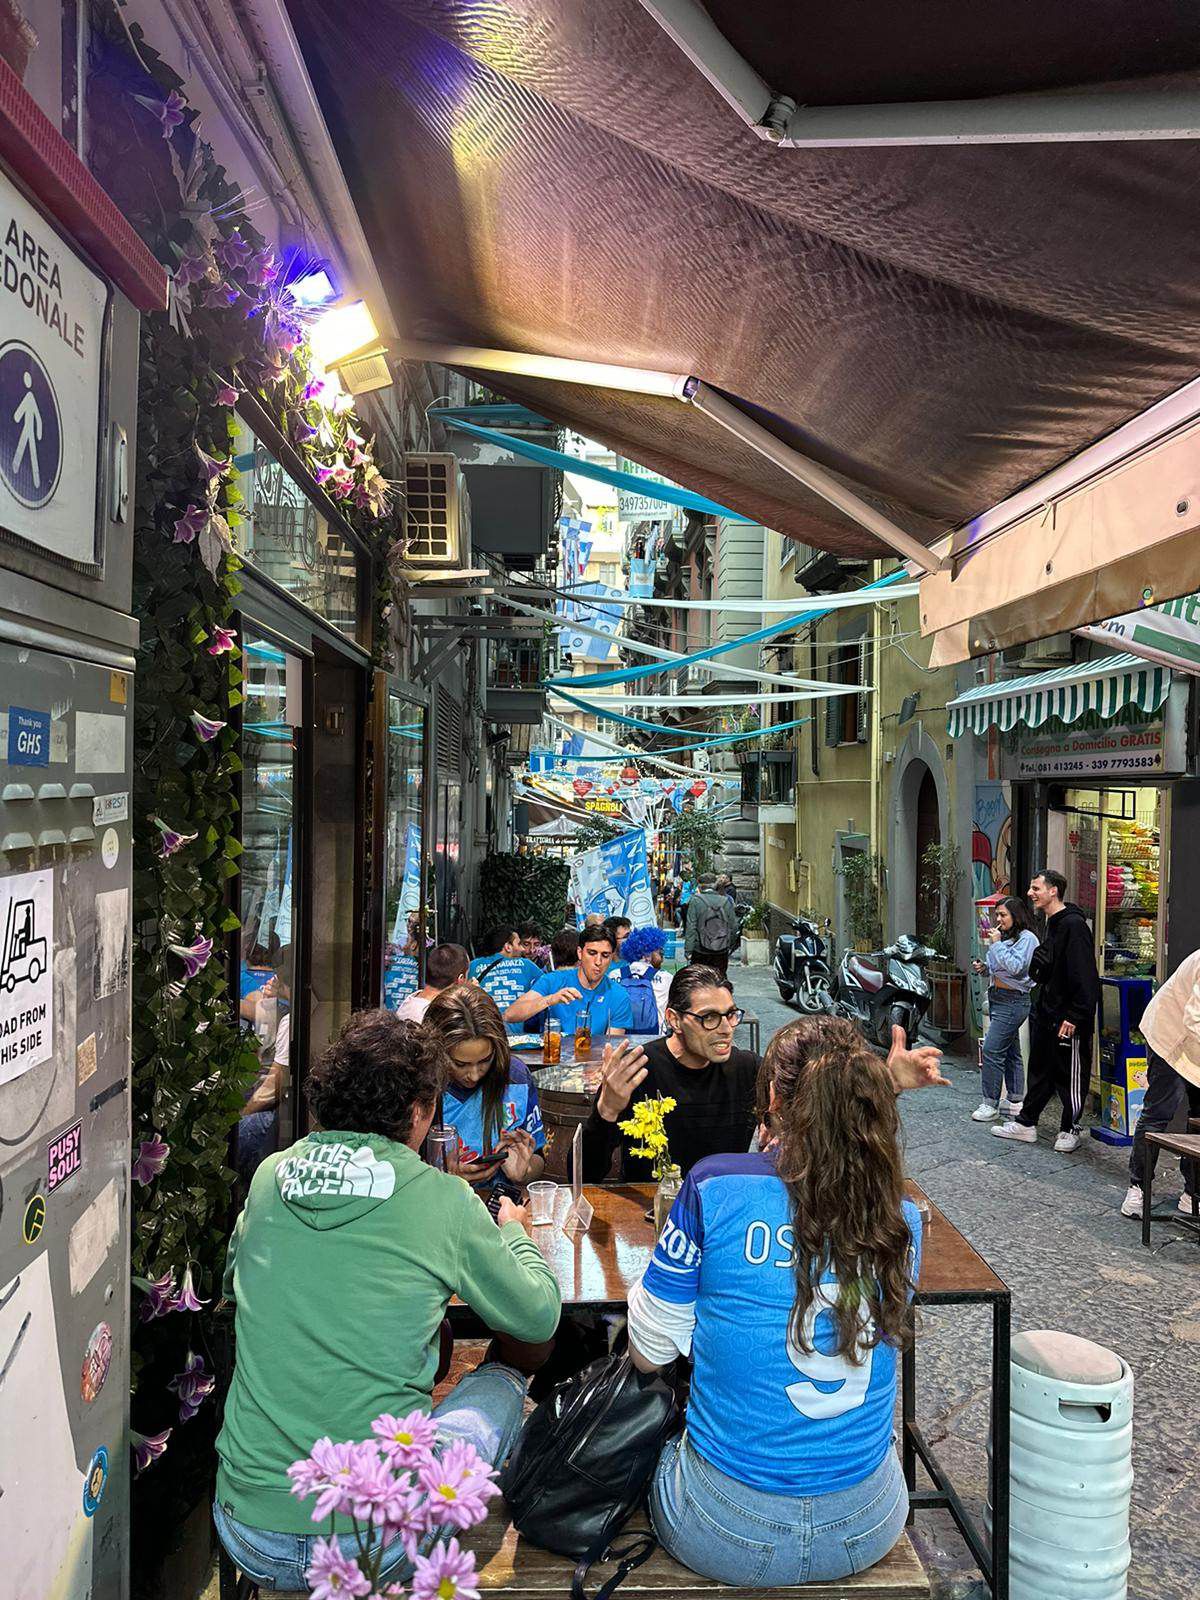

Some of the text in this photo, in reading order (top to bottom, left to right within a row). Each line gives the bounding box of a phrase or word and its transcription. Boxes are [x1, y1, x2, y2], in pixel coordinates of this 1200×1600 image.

[5, 218, 63, 300] AREA
[18, 715, 42, 729] Thank you
[17, 731, 42, 755] GHS
[1072, 737, 1117, 751] Domicilio
[1120, 731, 1161, 748] GRATIS
[1053, 761, 1084, 771] 413245
[1091, 759, 1108, 769] 339
[1110, 757, 1154, 768] 7793583
[20, 1003, 46, 1029] FROM
[20, 1030, 42, 1055] SIDE
[49, 1126, 81, 1168] PUSY
[307, 1142, 355, 1163] THE
[48, 1149, 81, 1189] SOUL
[277, 1158, 347, 1181] NORTH
[281, 1178, 343, 1202] FACE
[784, 1282, 874, 1421] 9
